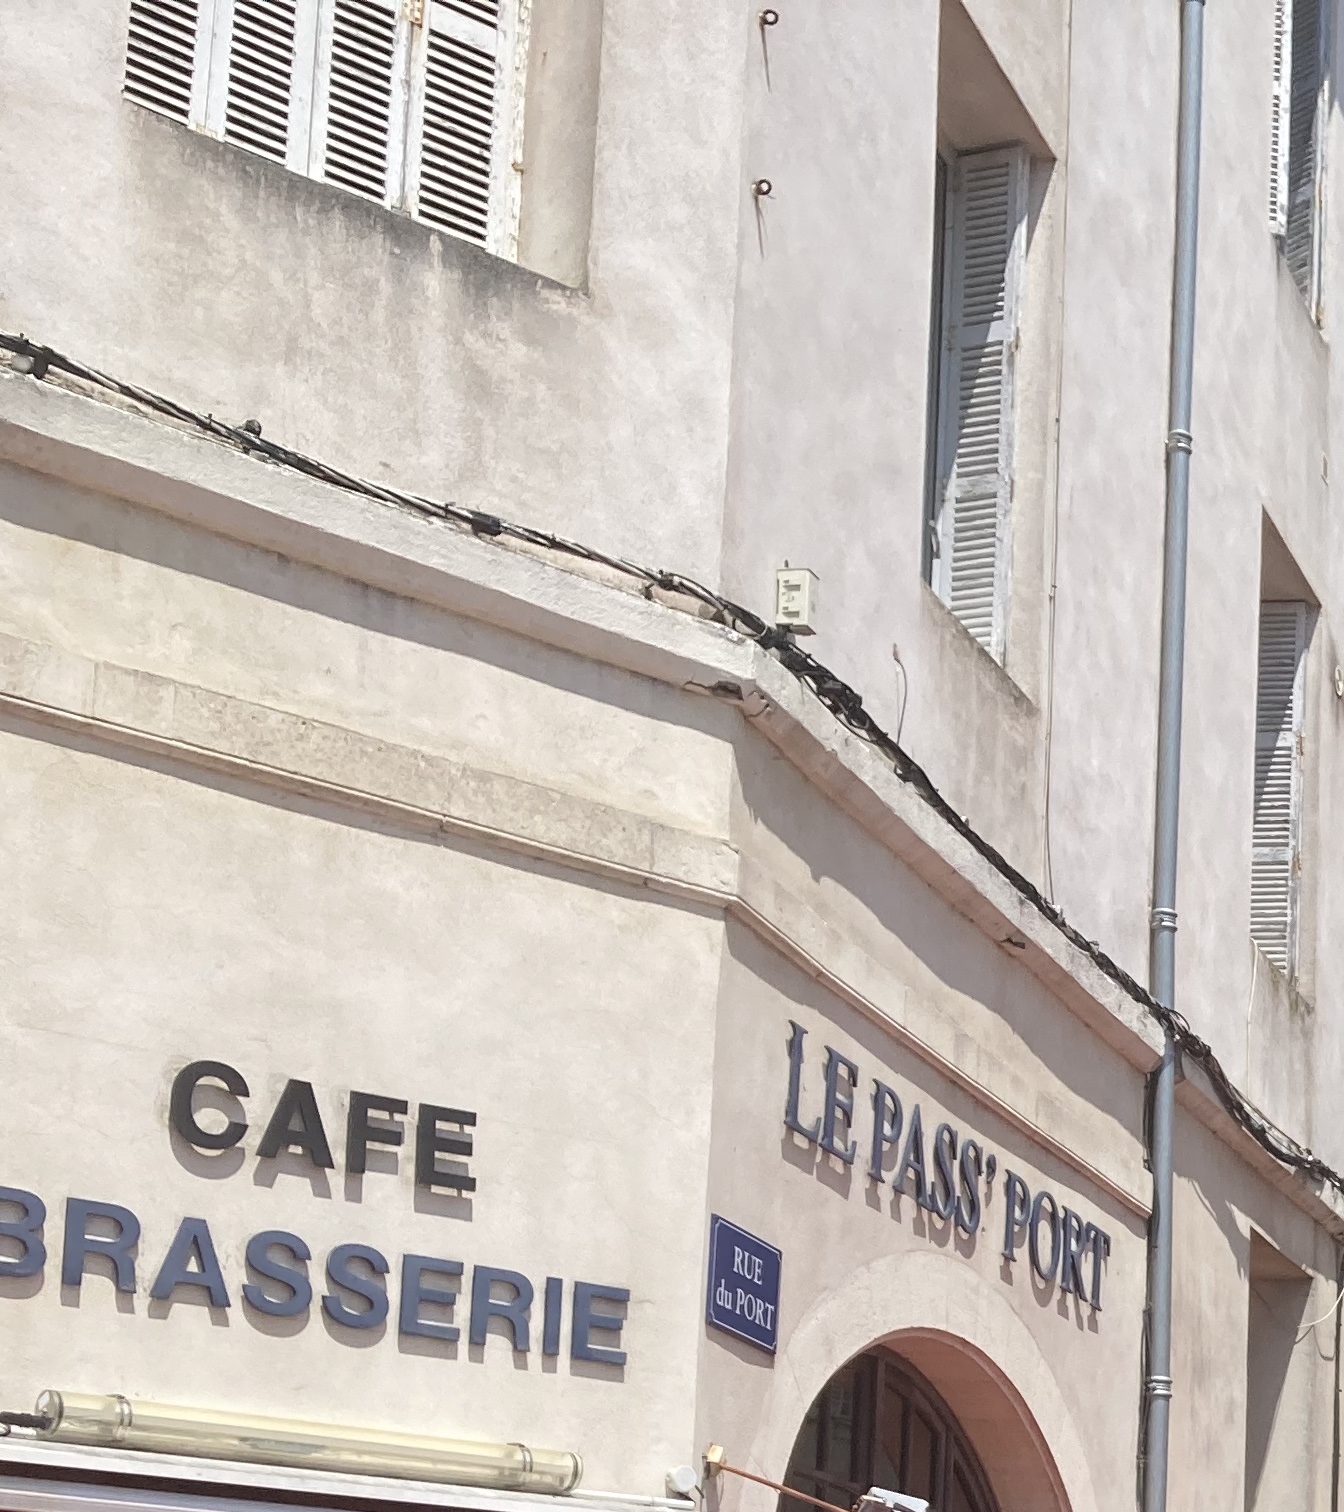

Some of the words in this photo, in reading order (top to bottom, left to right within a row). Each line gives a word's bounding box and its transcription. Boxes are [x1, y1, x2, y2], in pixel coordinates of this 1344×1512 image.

[169, 1059, 478, 1193] CAFE
[783, 1019, 859, 1165] LE
[0, 1186, 630, 1367] BRASSERIE
[716, 1279, 732, 1309] du
[735, 1292, 776, 1331] PORT
[732, 1245, 764, 1286] RUE
